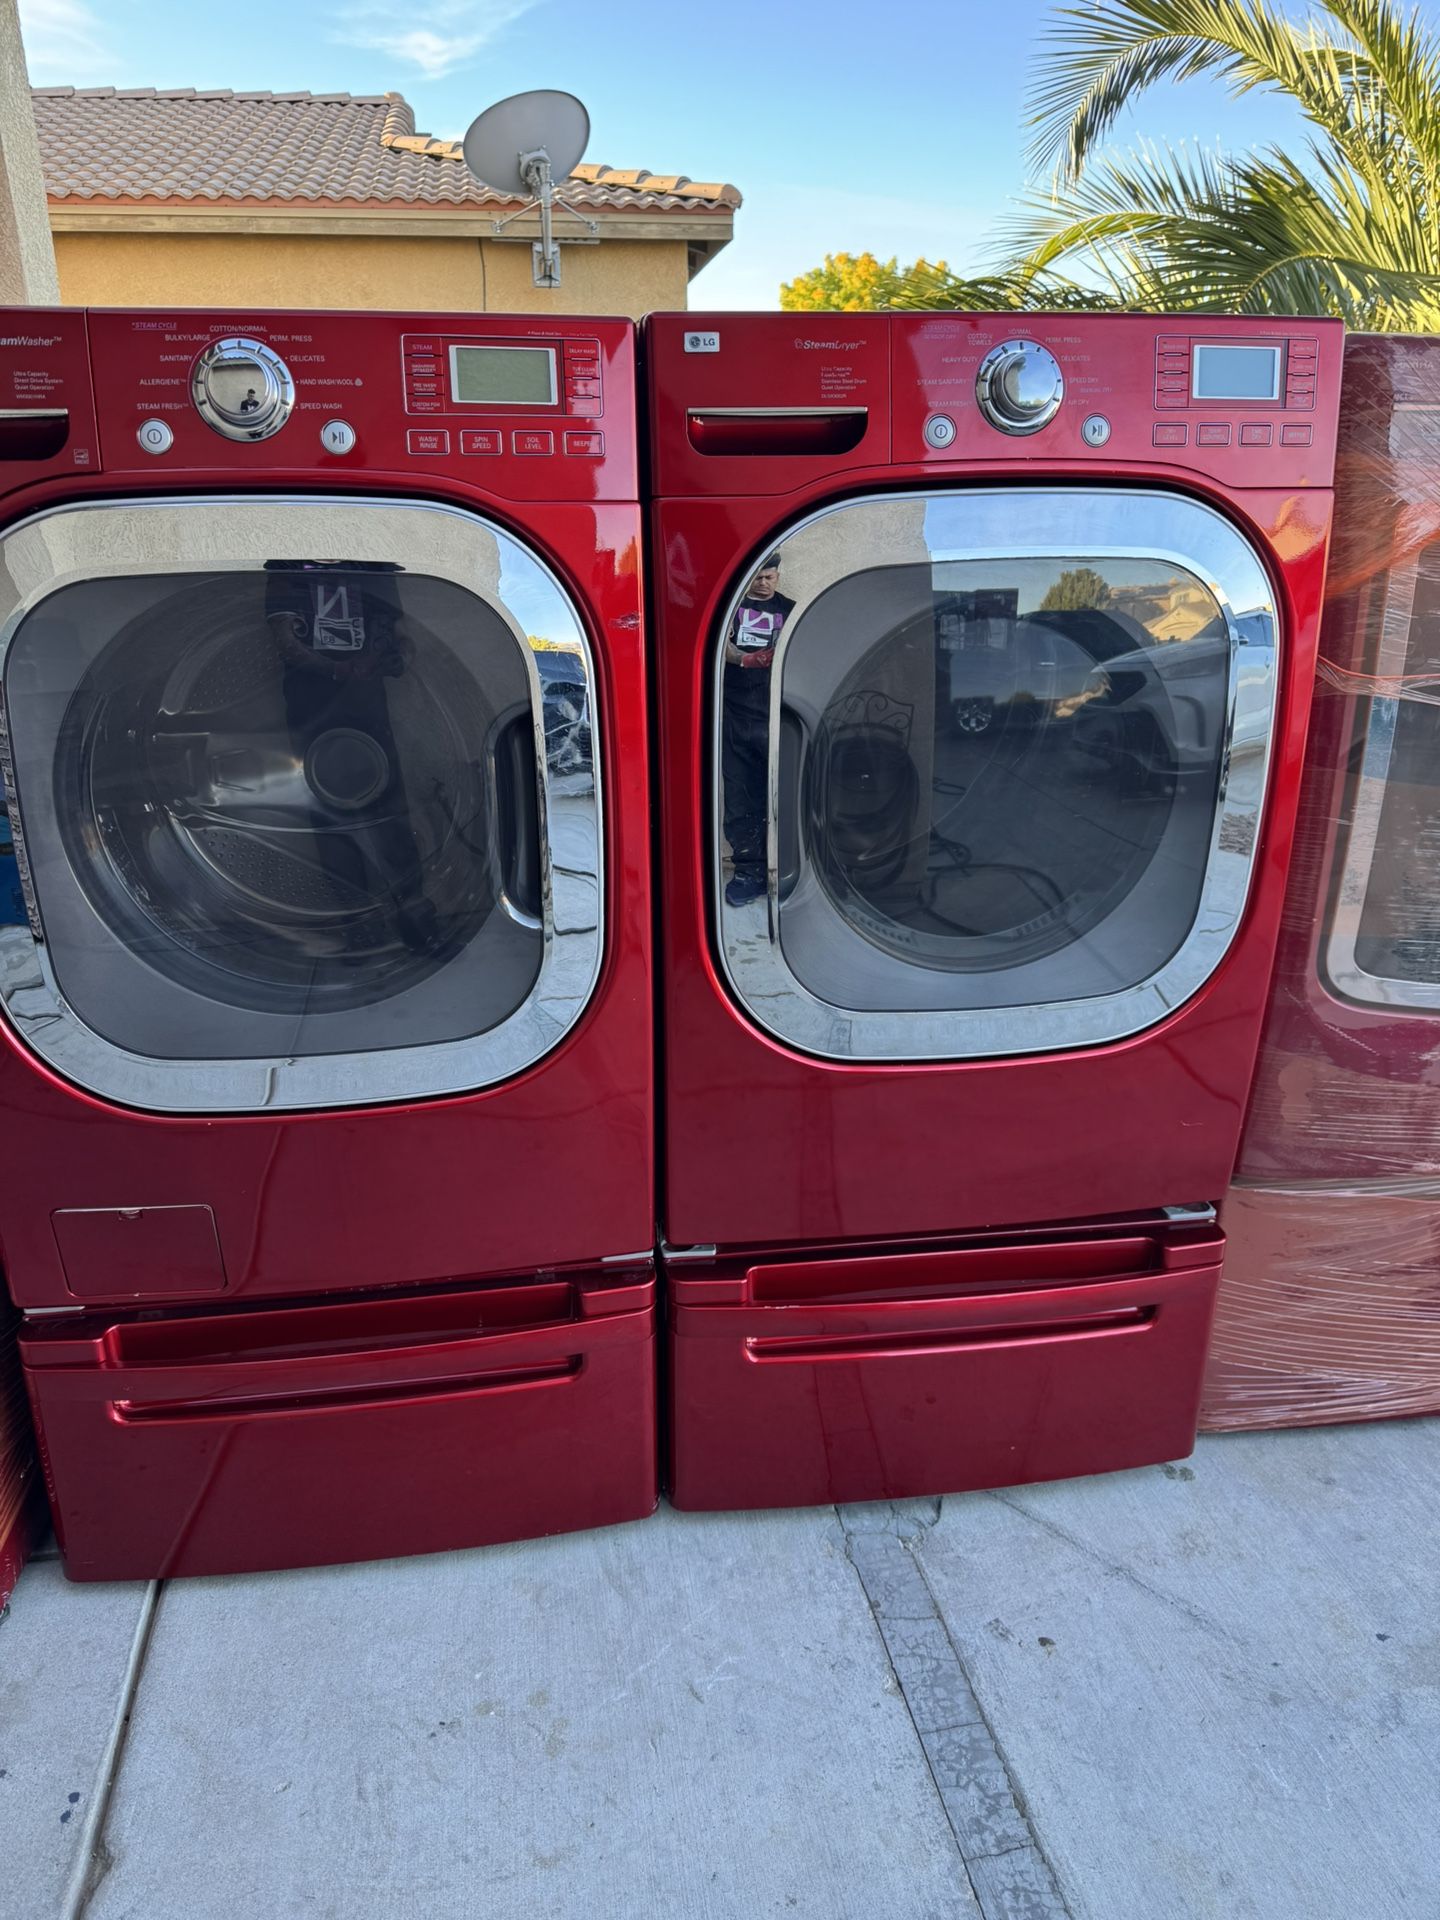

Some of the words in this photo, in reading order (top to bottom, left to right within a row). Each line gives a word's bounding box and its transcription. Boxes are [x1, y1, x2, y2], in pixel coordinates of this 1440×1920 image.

[269, 334, 289, 342] PERM.
[291, 334, 312, 342] PRESS
[703, 337, 716, 346] LG
[300, 378, 317, 386] HAND
